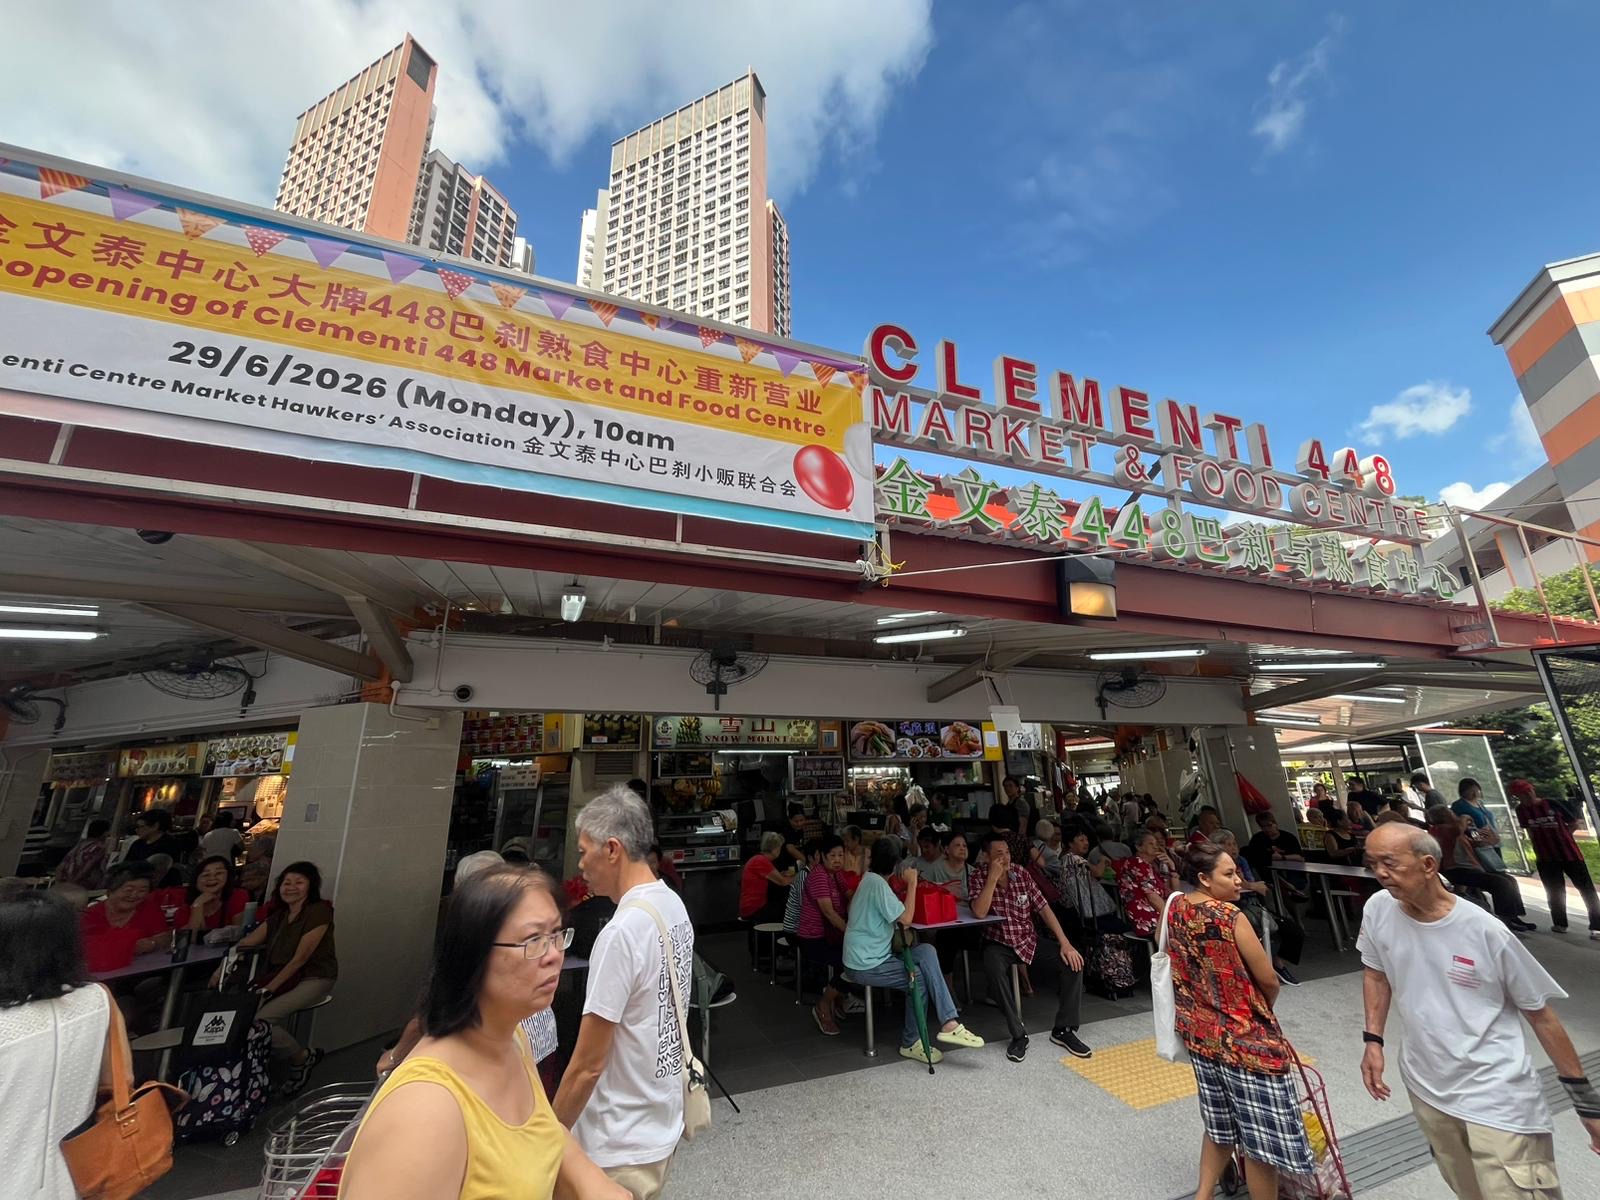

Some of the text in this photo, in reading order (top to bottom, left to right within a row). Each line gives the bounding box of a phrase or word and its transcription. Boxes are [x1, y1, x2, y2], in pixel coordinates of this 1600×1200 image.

[0, 257, 826, 437] opening of Clementi 448 Market and Food Centre
[168, 341, 675, 451] 29/6/2026 (Monday), 10am
[866, 323, 1396, 497] CLEMENTI 448
[68, 363, 166, 390] Centre
[171, 379, 267, 407] Market
[388, 416, 516, 450] Association
[522, 435, 797, 498] 金文泰中心巴刹小贩联合会
[864, 385, 1429, 538] MARKET & FOOD CENTRE
[875, 455, 1460, 600] 金文泰448巴刹与熟食中心
[704, 735, 740, 743] SNOW
